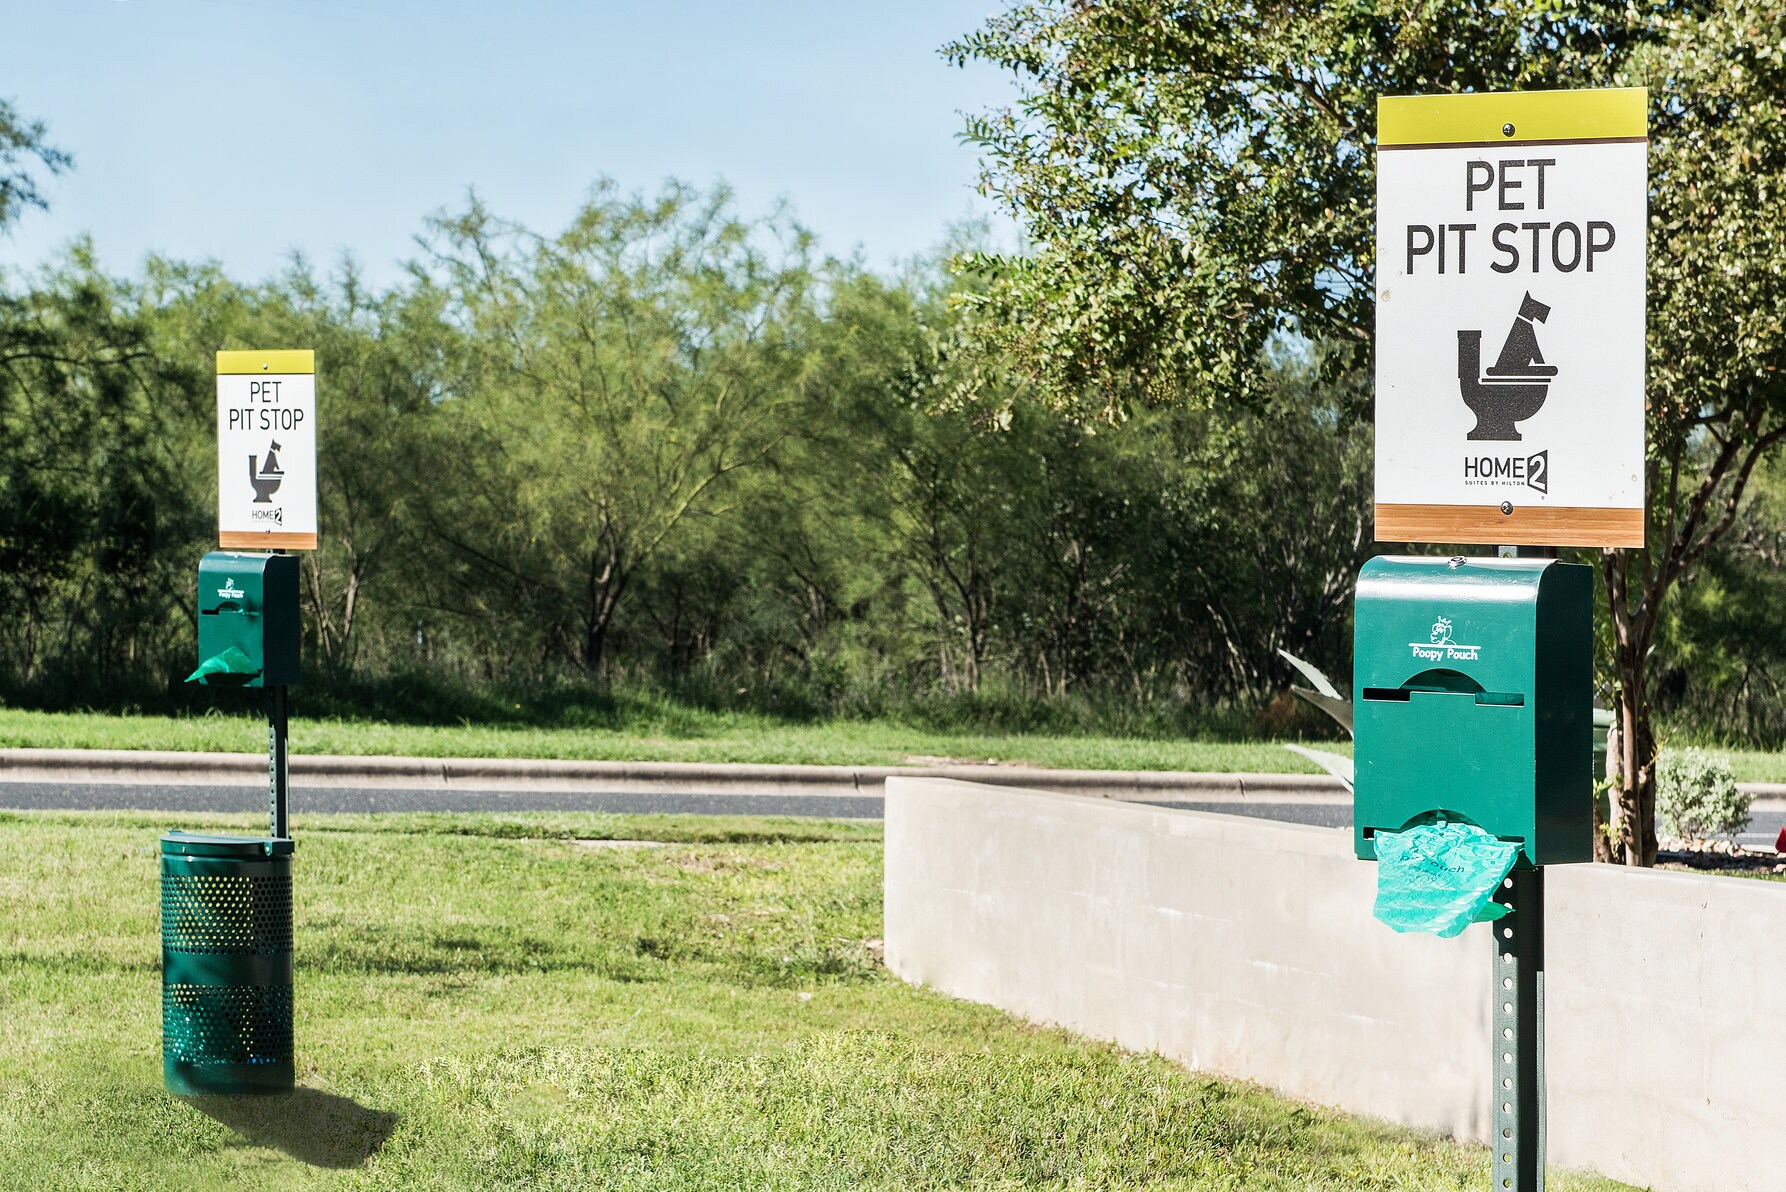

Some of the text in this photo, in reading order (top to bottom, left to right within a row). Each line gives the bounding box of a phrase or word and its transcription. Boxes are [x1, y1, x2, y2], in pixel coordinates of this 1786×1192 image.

[1466, 158, 1556, 211] PET
[1406, 220, 1616, 275] PIT STOP
[250, 381, 282, 403] PET
[229, 408, 304, 431] PIT STOP
[1412, 646, 1478, 661] Poopy Pouch
